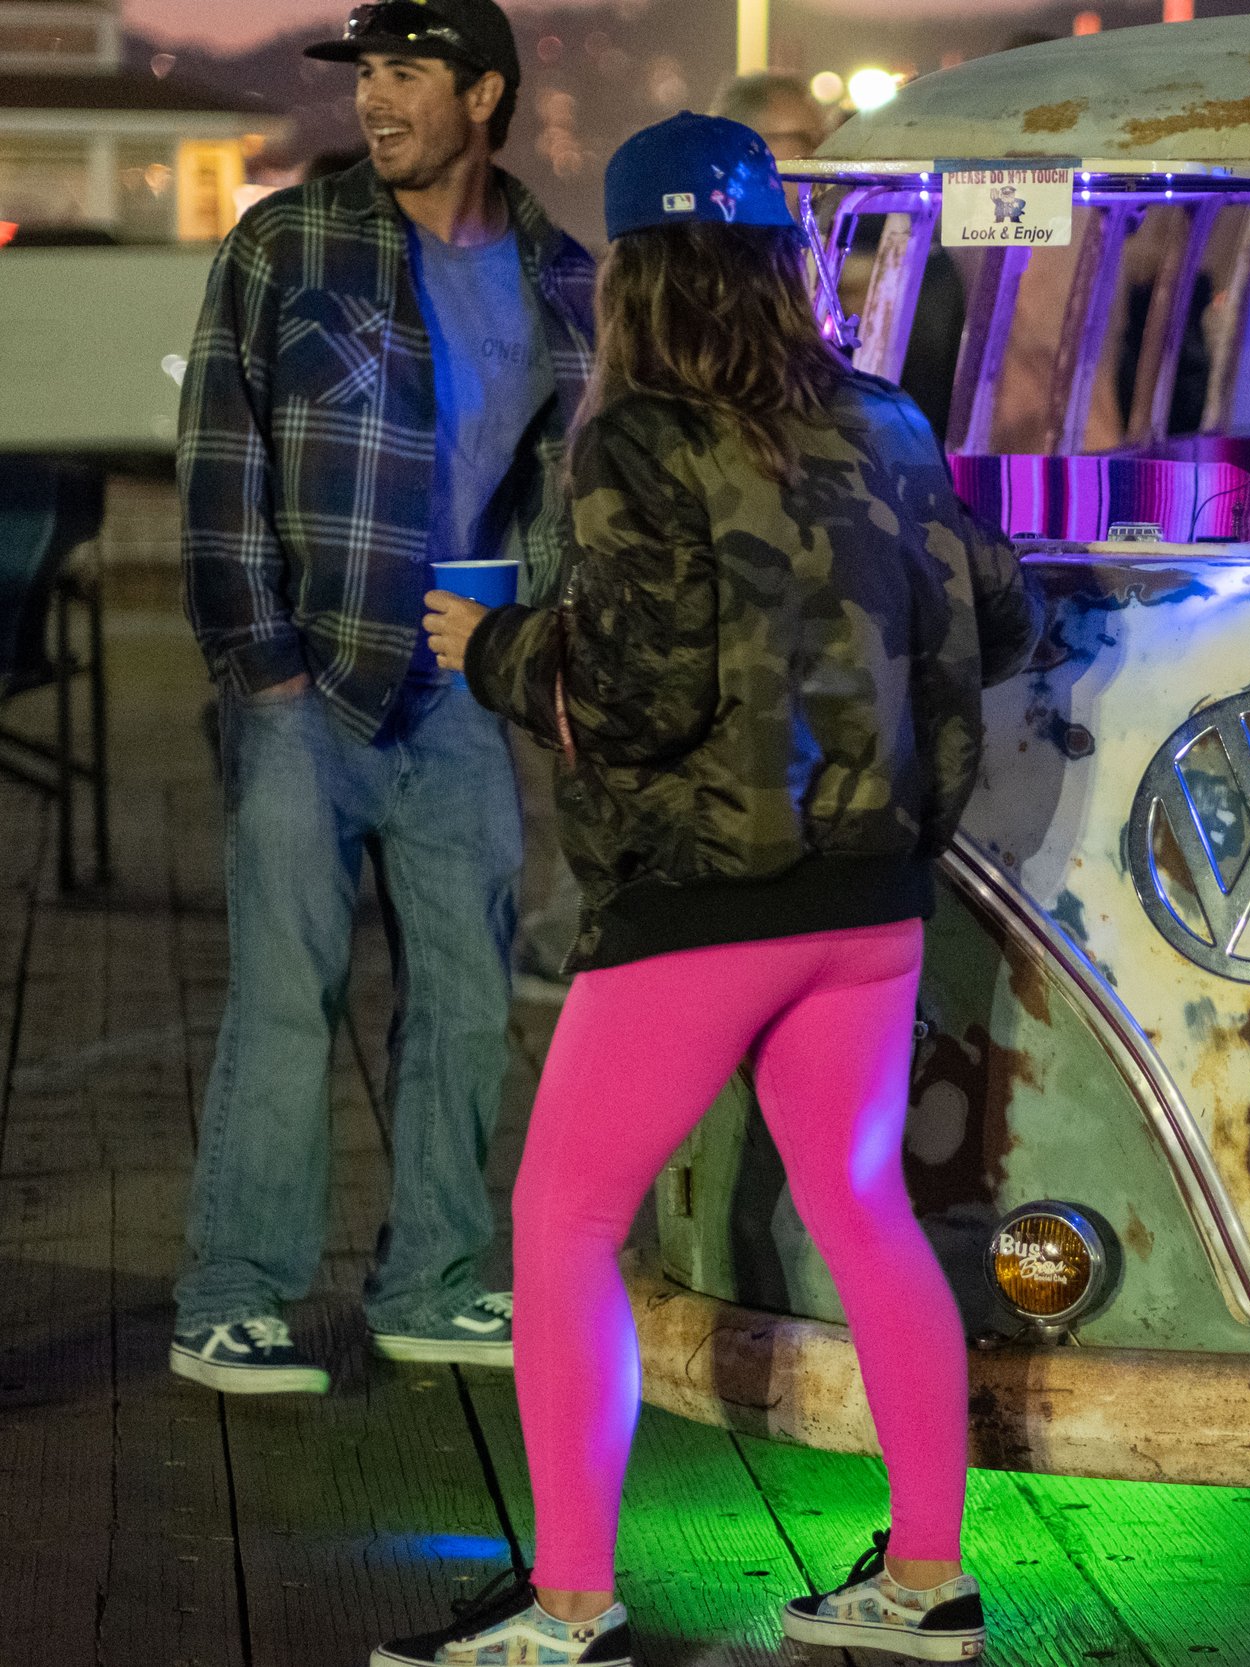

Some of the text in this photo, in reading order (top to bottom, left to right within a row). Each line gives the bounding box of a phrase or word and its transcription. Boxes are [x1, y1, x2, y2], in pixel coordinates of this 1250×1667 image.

[948, 169, 1069, 184] PLEASE DO NOT TOUCH!
[962, 226, 1053, 243] Look & Enjoy
[1000, 1233, 1041, 1259] Bus
